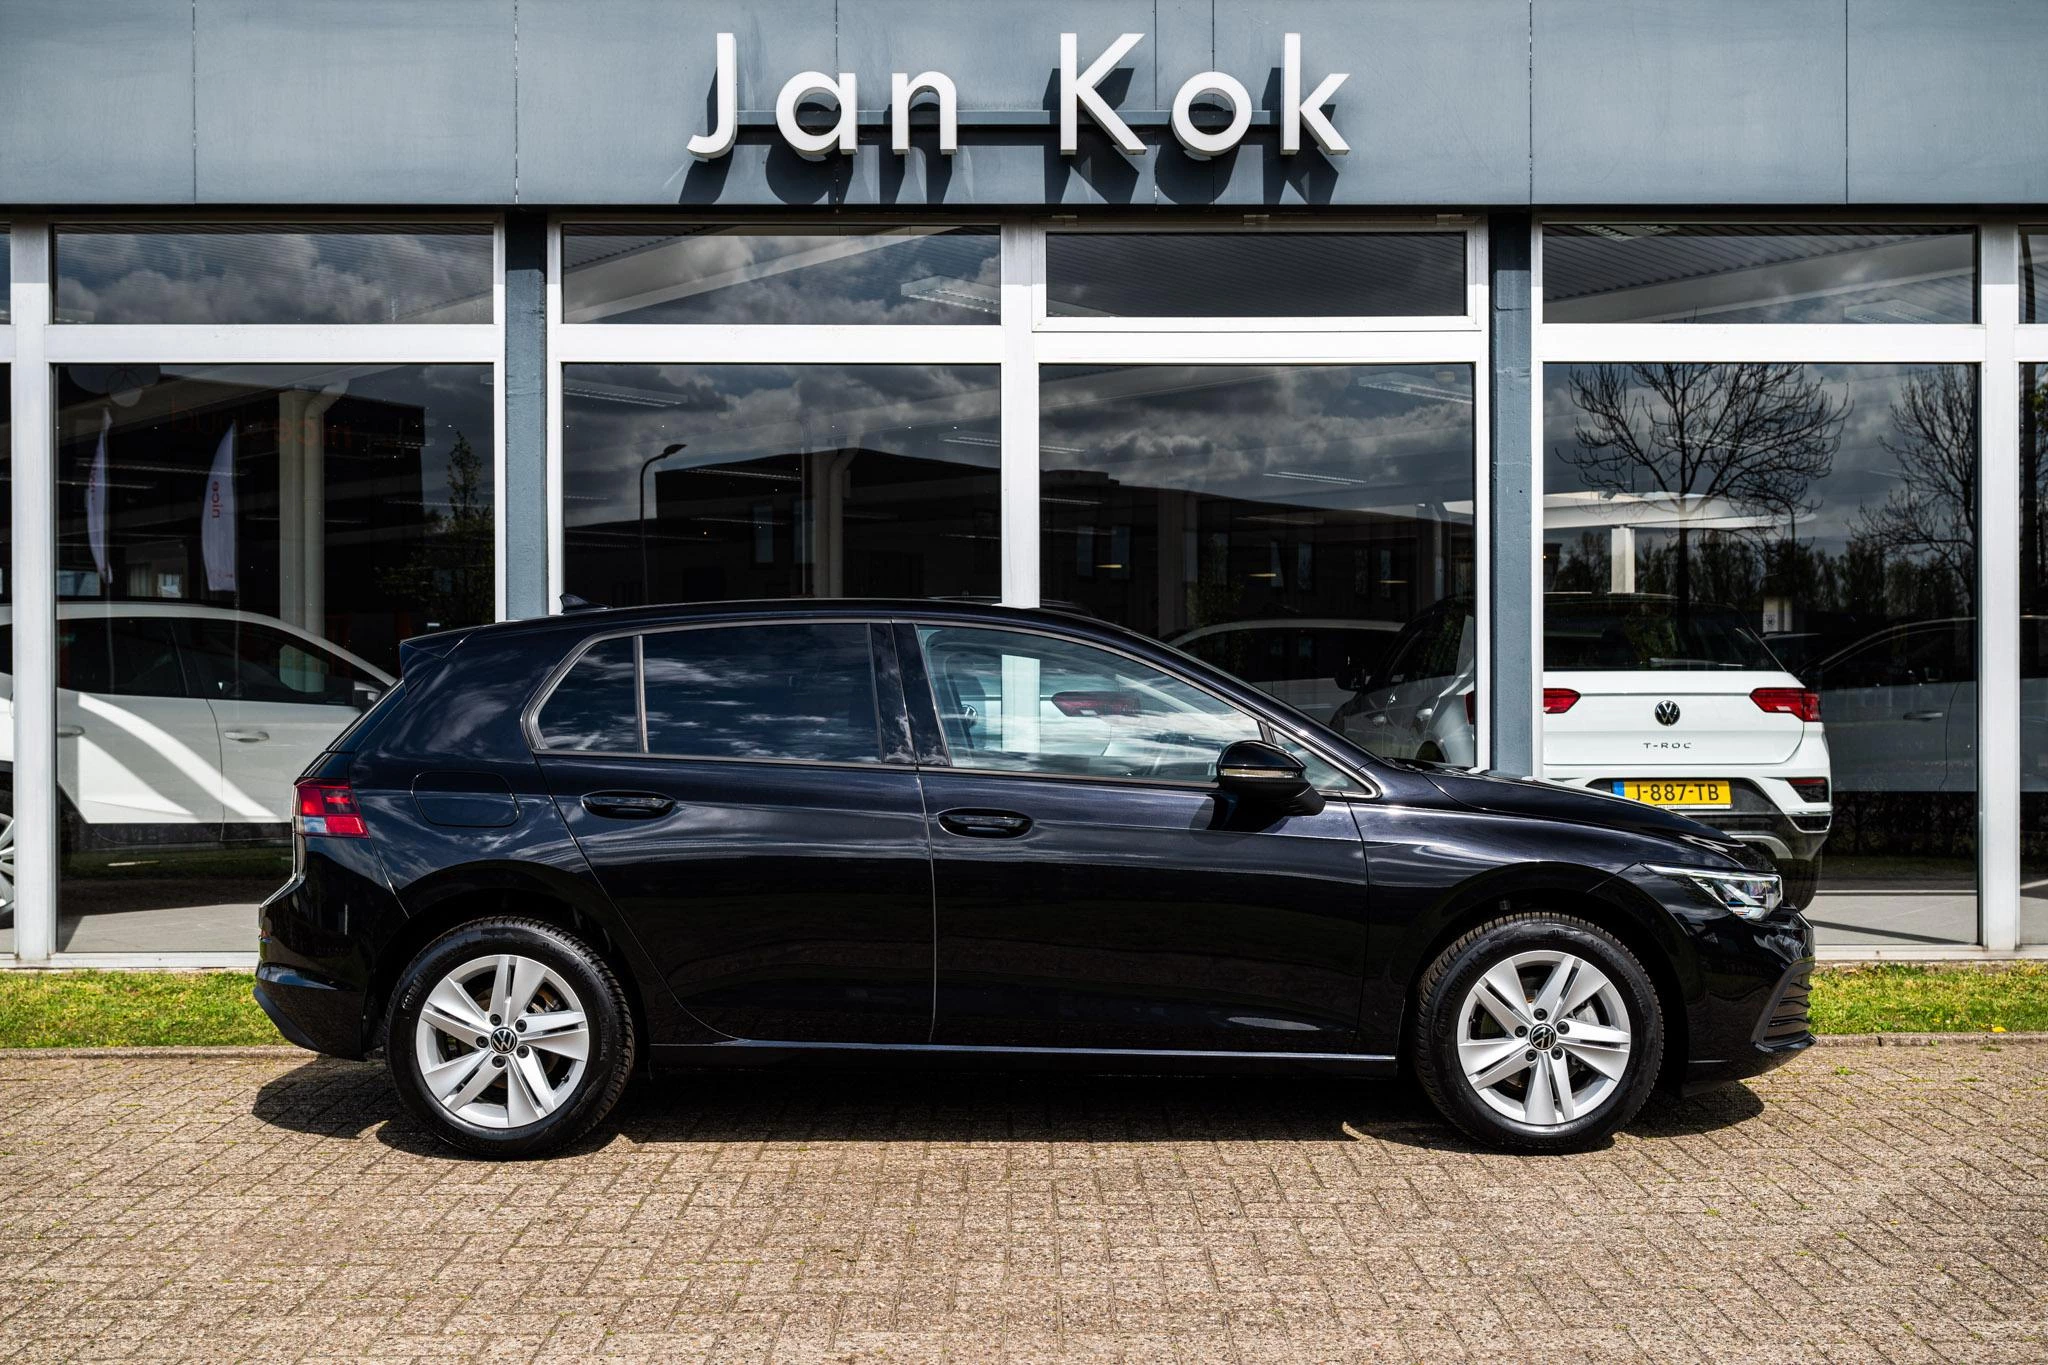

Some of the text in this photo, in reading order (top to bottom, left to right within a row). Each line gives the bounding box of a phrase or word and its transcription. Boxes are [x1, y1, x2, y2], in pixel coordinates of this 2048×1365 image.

[686, 33, 1351, 159] Jan Kok
[1633, 784, 1719, 801] J-887-TB
